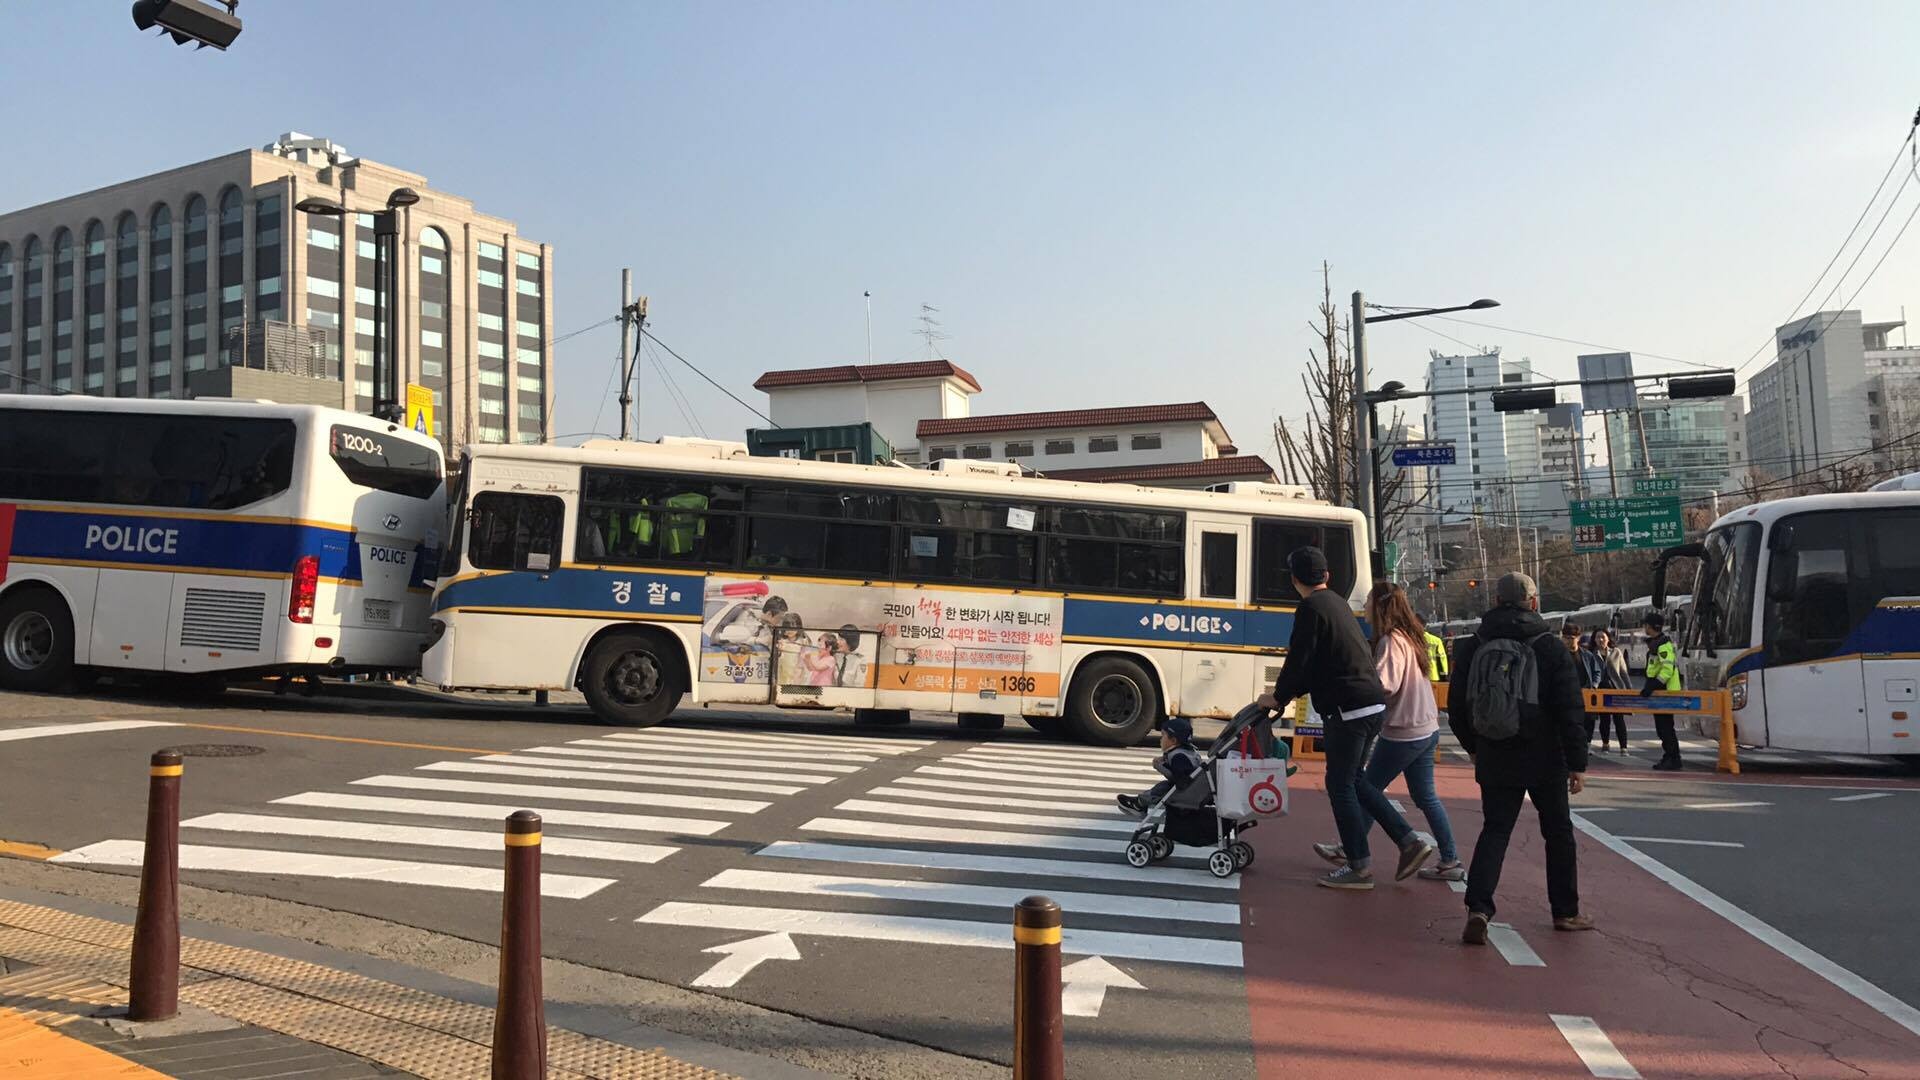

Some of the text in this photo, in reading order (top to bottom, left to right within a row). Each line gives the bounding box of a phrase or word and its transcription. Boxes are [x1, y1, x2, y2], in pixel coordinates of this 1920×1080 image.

[342, 432, 383, 456] 1200-2
[85, 524, 179, 554] POLICE
[370, 547, 407, 565] POLICE
[883, 603, 915, 618] 국민이
[959, 608, 991, 623] 변화가
[993, 609, 1014, 625] 시작
[1016, 611, 1051, 627] 됩니다!
[1152, 612, 1222, 635] POLICE
[900, 625, 945, 640] 만들어요!
[947, 627, 975, 643] 4대악
[977, 628, 998, 643] 없는
[1000, 630, 1031, 645] 안전한
[1033, 632, 1055, 647] 세상
[723, 665, 754, 678] 경찰청
[914, 673, 945, 689] 성폭력
[1000, 675, 1036, 693] 1366
